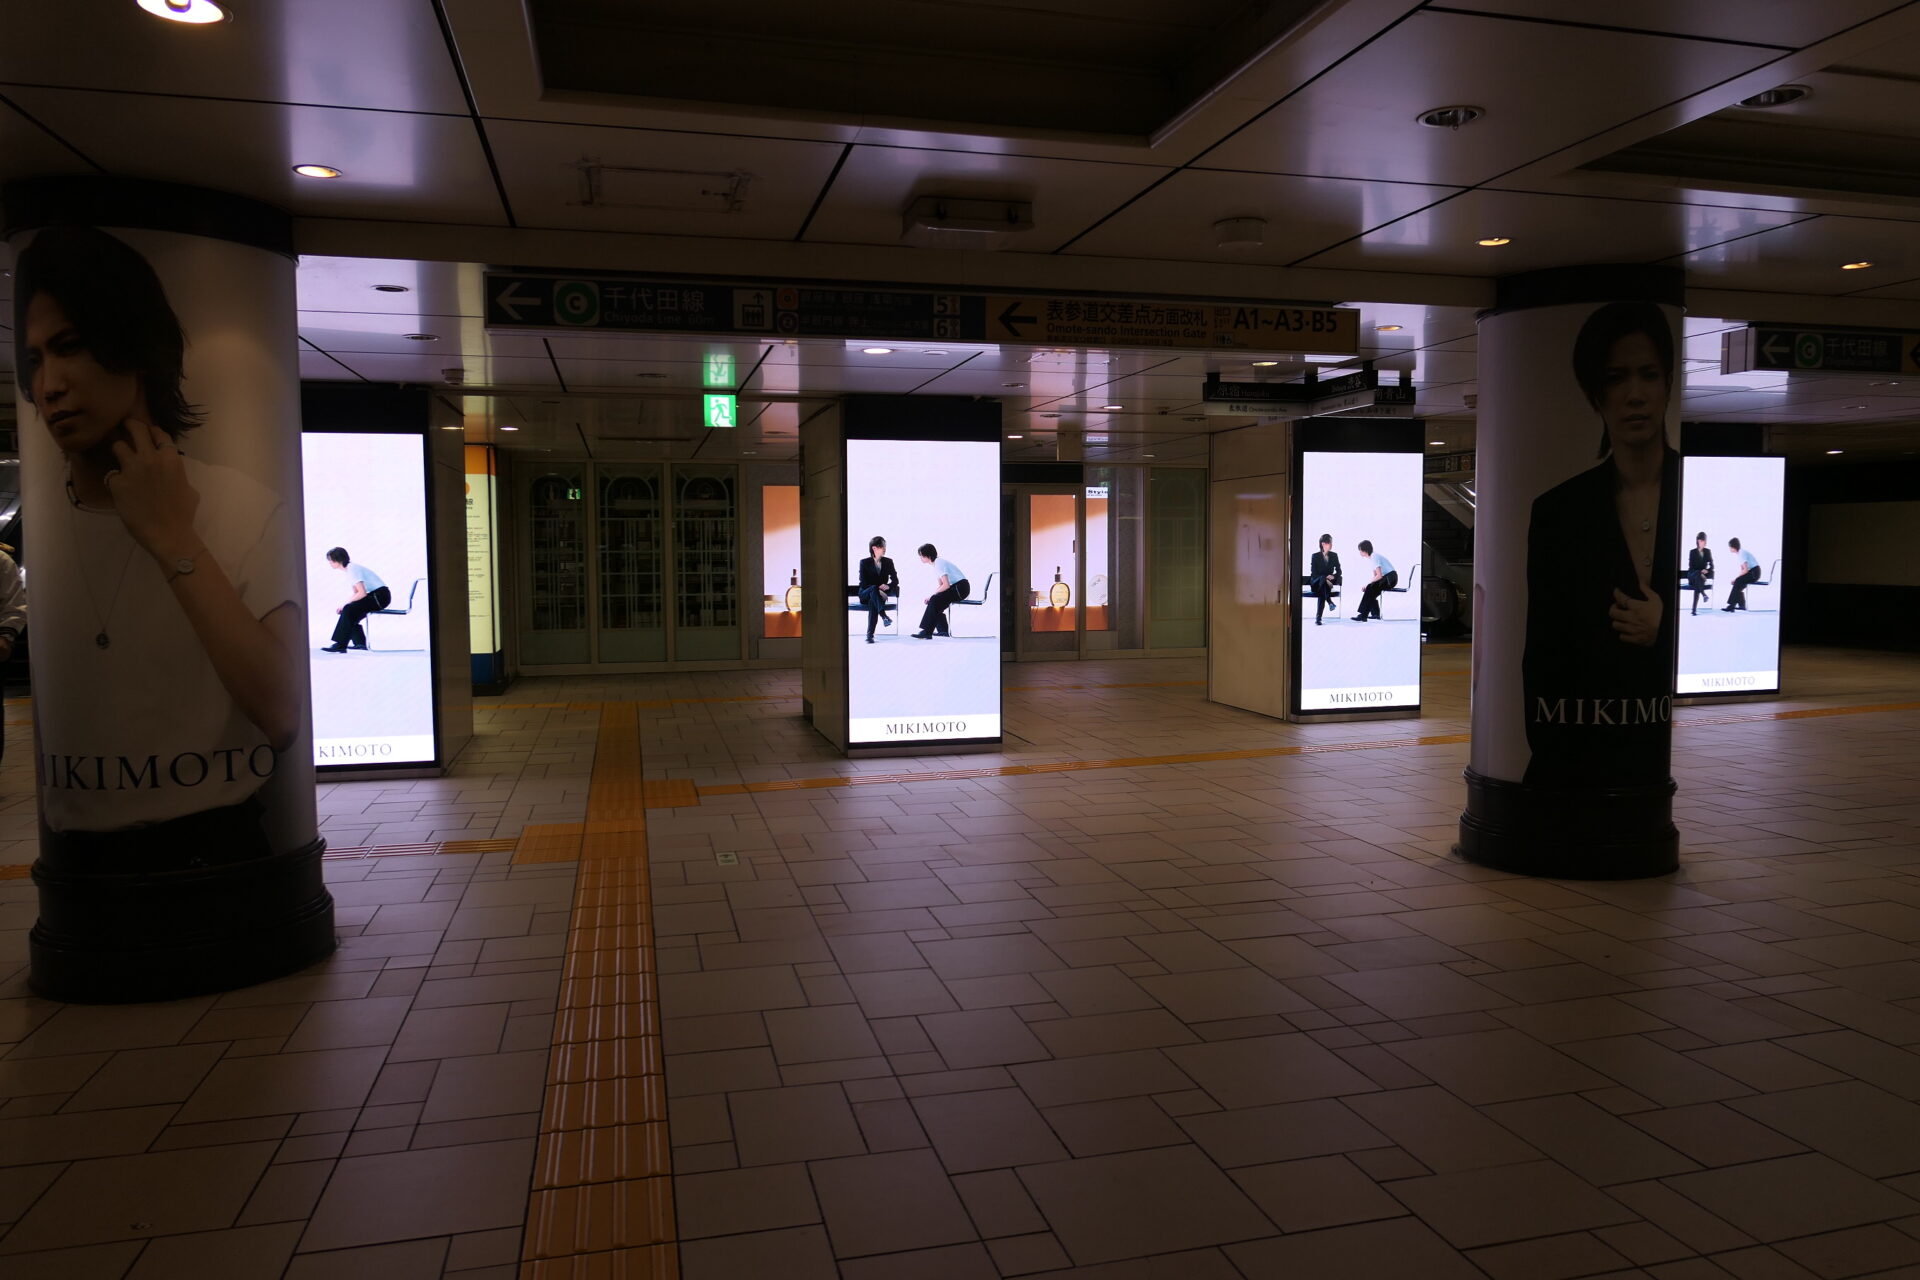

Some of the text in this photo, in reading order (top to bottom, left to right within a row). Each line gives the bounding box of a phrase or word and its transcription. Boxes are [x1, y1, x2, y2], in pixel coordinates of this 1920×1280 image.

[569, 296, 581, 310] C
[603, 287, 705, 312] 千代田線
[936, 297, 948, 313] 5
[603, 311, 653, 327] Chiyoda
[1047, 300, 1208, 327] 表参道交差点方面改札
[936, 320, 948, 336] 6
[1047, 323, 1207, 338] Omote-sando Intersection Gate
[1702, 676, 1756, 687] MIKIMOTO
[1329, 691, 1393, 704] MIKIMOTO
[885, 721, 967, 735] MIKIMOTO
[319, 743, 392, 758] KIMOTO
